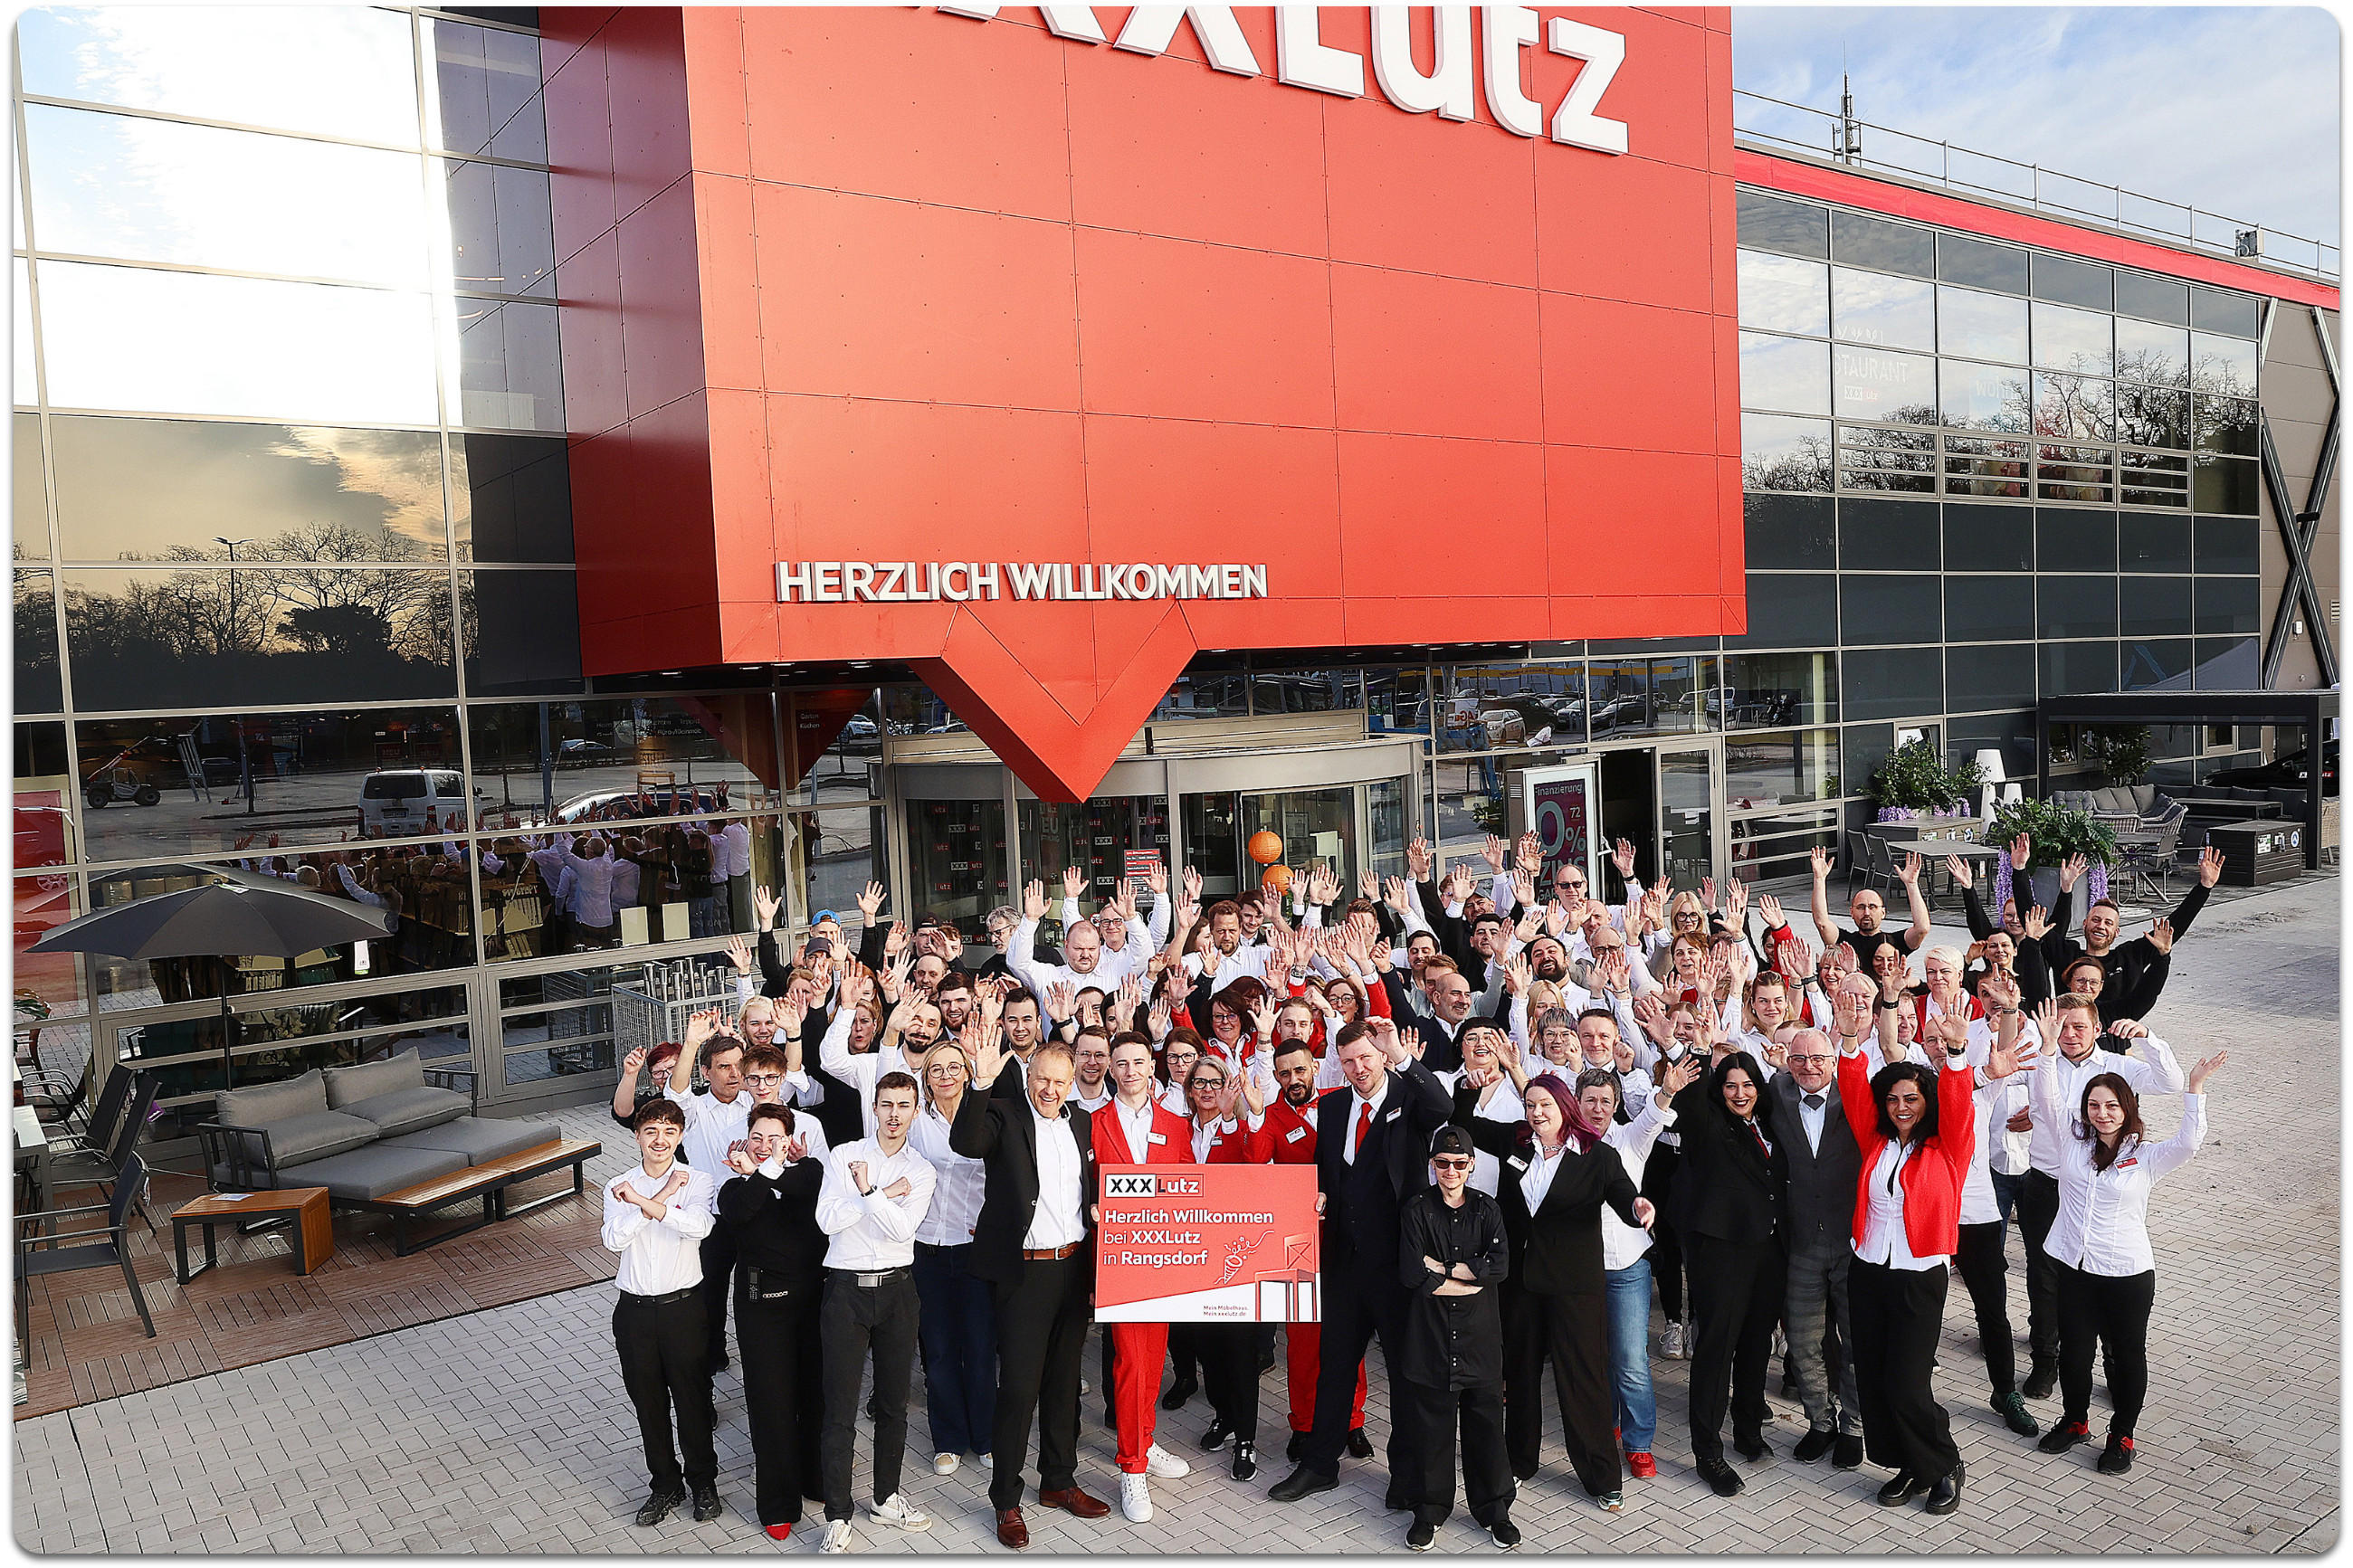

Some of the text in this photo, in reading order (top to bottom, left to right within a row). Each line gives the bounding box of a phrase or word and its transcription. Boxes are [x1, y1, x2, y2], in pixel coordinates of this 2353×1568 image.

[936, 6, 1629, 156] Lutz
[776, 561, 1269, 603] HERZLICH WILLKOMMEN
[1570, 806, 1581, 819] 72
[1110, 1178, 1200, 1193] XXXLutz
[1104, 1209, 1274, 1224] Herzlich Willkommen
[1103, 1230, 1201, 1244] bei XXXLutz
[1103, 1250, 1208, 1269] in Rangsdorf
